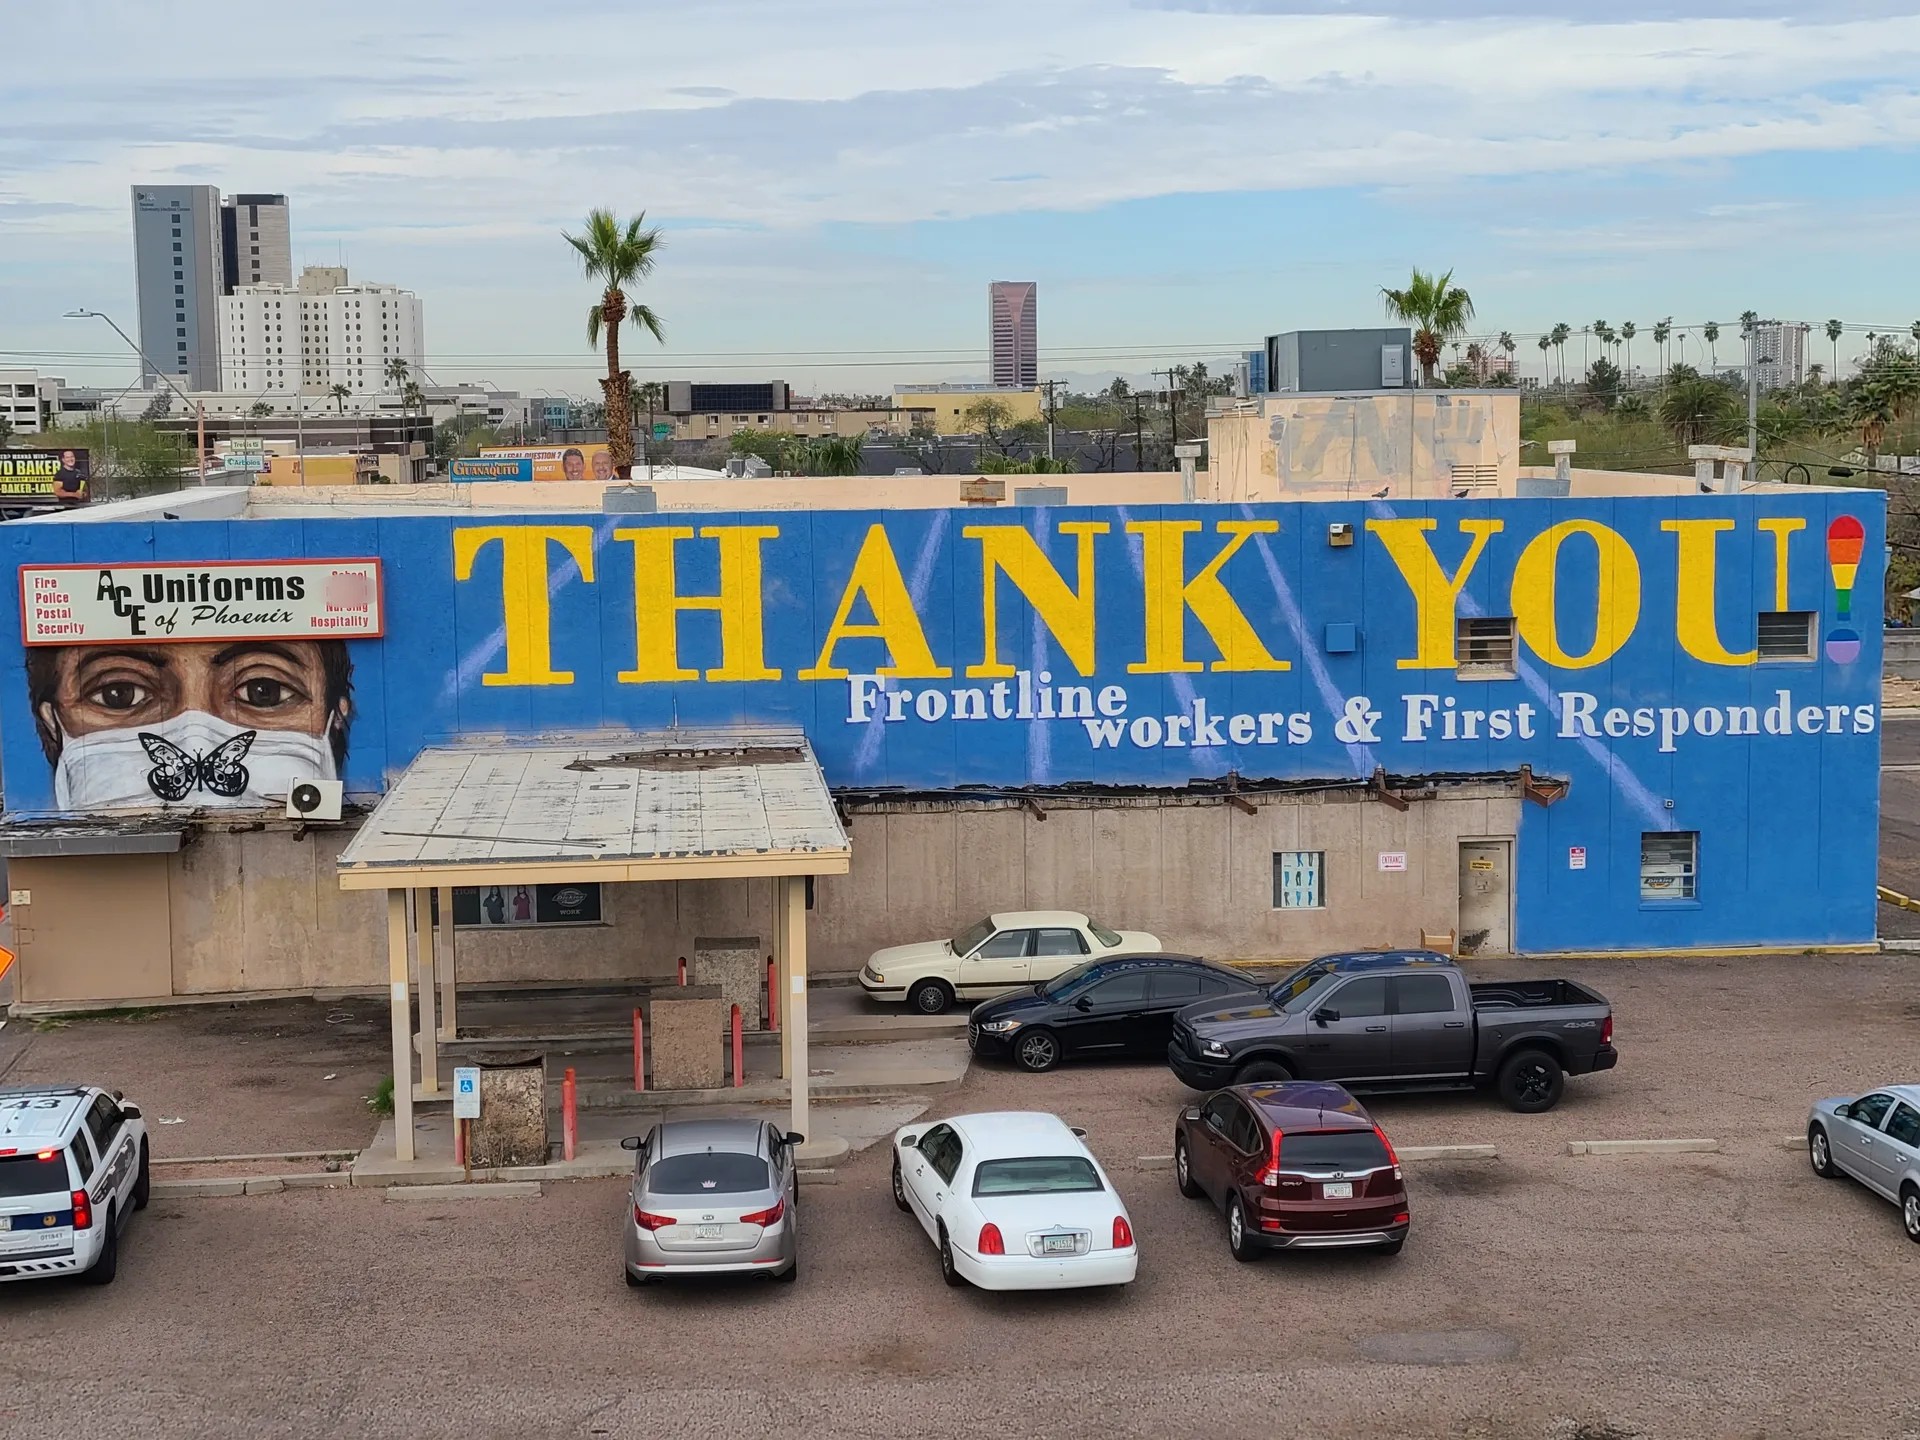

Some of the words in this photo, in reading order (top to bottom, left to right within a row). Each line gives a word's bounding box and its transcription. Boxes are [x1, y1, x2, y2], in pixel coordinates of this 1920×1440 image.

[525, 452, 556, 460] QUESTION
[16, 460, 61, 475] BAKER
[35, 577, 57, 588] Fire
[36, 592, 69, 604] Police
[97, 570, 146, 635] ACE
[143, 573, 305, 603] Uniforms
[453, 519, 1291, 687] THANK
[1366, 513, 1866, 669] YOU!
[37, 607, 71, 619] Postal
[154, 607, 179, 634] of
[191, 605, 293, 626] Phoenix
[310, 616, 369, 628] Hospitality
[37, 622, 84, 634] Security
[846, 671, 1128, 723] Frontline
[1082, 698, 1312, 749] workers
[1334, 696, 1382, 745] &
[1401, 694, 1536, 741] First
[1557, 690, 1875, 753] Responders
[1382, 856, 1404, 864] ENTRANCE
